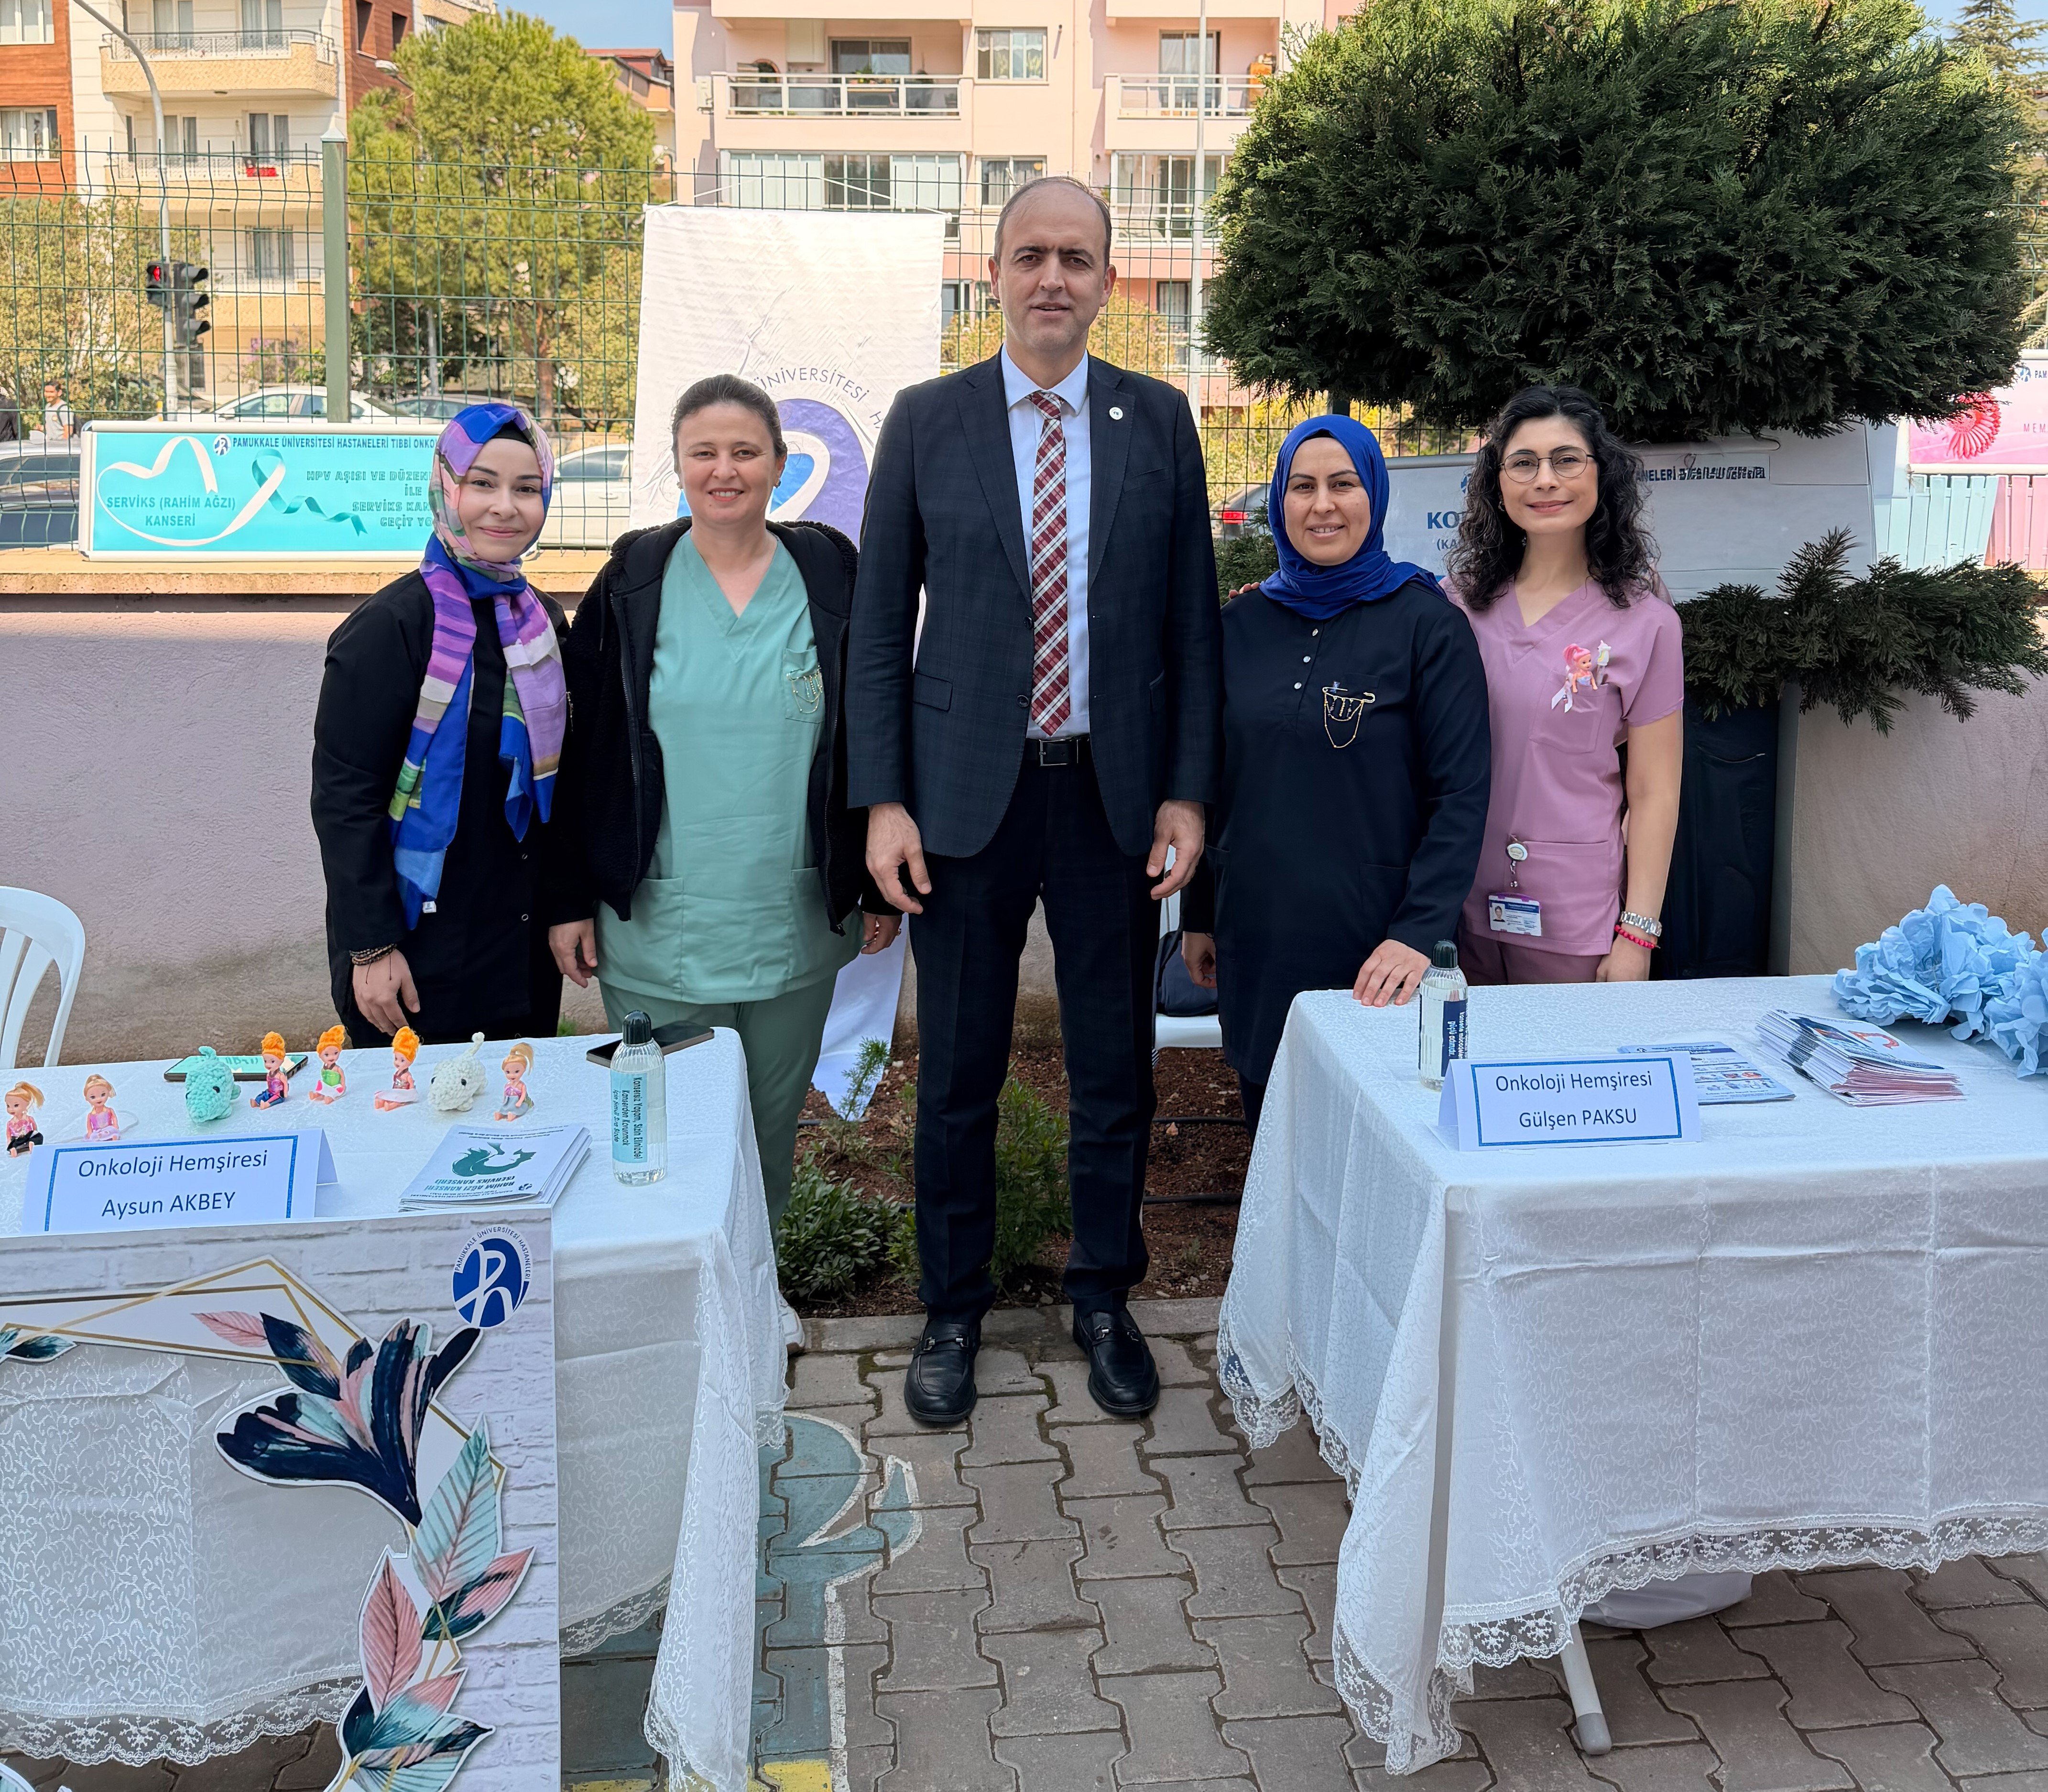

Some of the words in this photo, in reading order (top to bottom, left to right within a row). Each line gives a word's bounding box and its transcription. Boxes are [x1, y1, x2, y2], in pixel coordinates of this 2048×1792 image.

[233, 437, 279, 448] PAMUKKALE
[282, 436, 334, 448] ÜNİVERSİTESİ
[337, 437, 388, 448] HASTANELERİ
[391, 437, 411, 448] TIBBİ
[414, 438, 436, 448] ONKO
[306, 470, 331, 481] HPV
[335, 470, 366, 483] AŞISI
[370, 471, 386, 481] VE
[404, 483, 422, 496] İLE
[107, 494, 155, 508] SERVİKS
[160, 495, 200, 511] (RAHİM
[204, 495, 235, 511] AĞZI)
[352, 499, 403, 512] SERVİKS
[145, 513, 196, 526] KANSERİ
[380, 514, 413, 529] GEÇİT
[1427, 511, 1466, 529] KO
[1496, 1073, 1565, 1093] Onkoloji
[1570, 1071, 1652, 1091] Hemşiresi
[1519, 1111, 1577, 1130] Gülşen
[1582, 1108, 1636, 1125] PAKSU
[78, 1156, 163, 1177] Onkoloji
[170, 1149, 268, 1173] Hemşiresi
[101, 1199, 163, 1220] Aysun
[170, 1191, 236, 1212] AKBEY
[455, 1237, 477, 1271] PAMUKKALE
[477, 1226, 520, 1239] ÜNİVERSİTESİ
[518, 1240, 531, 1280] HASTANELERİ
